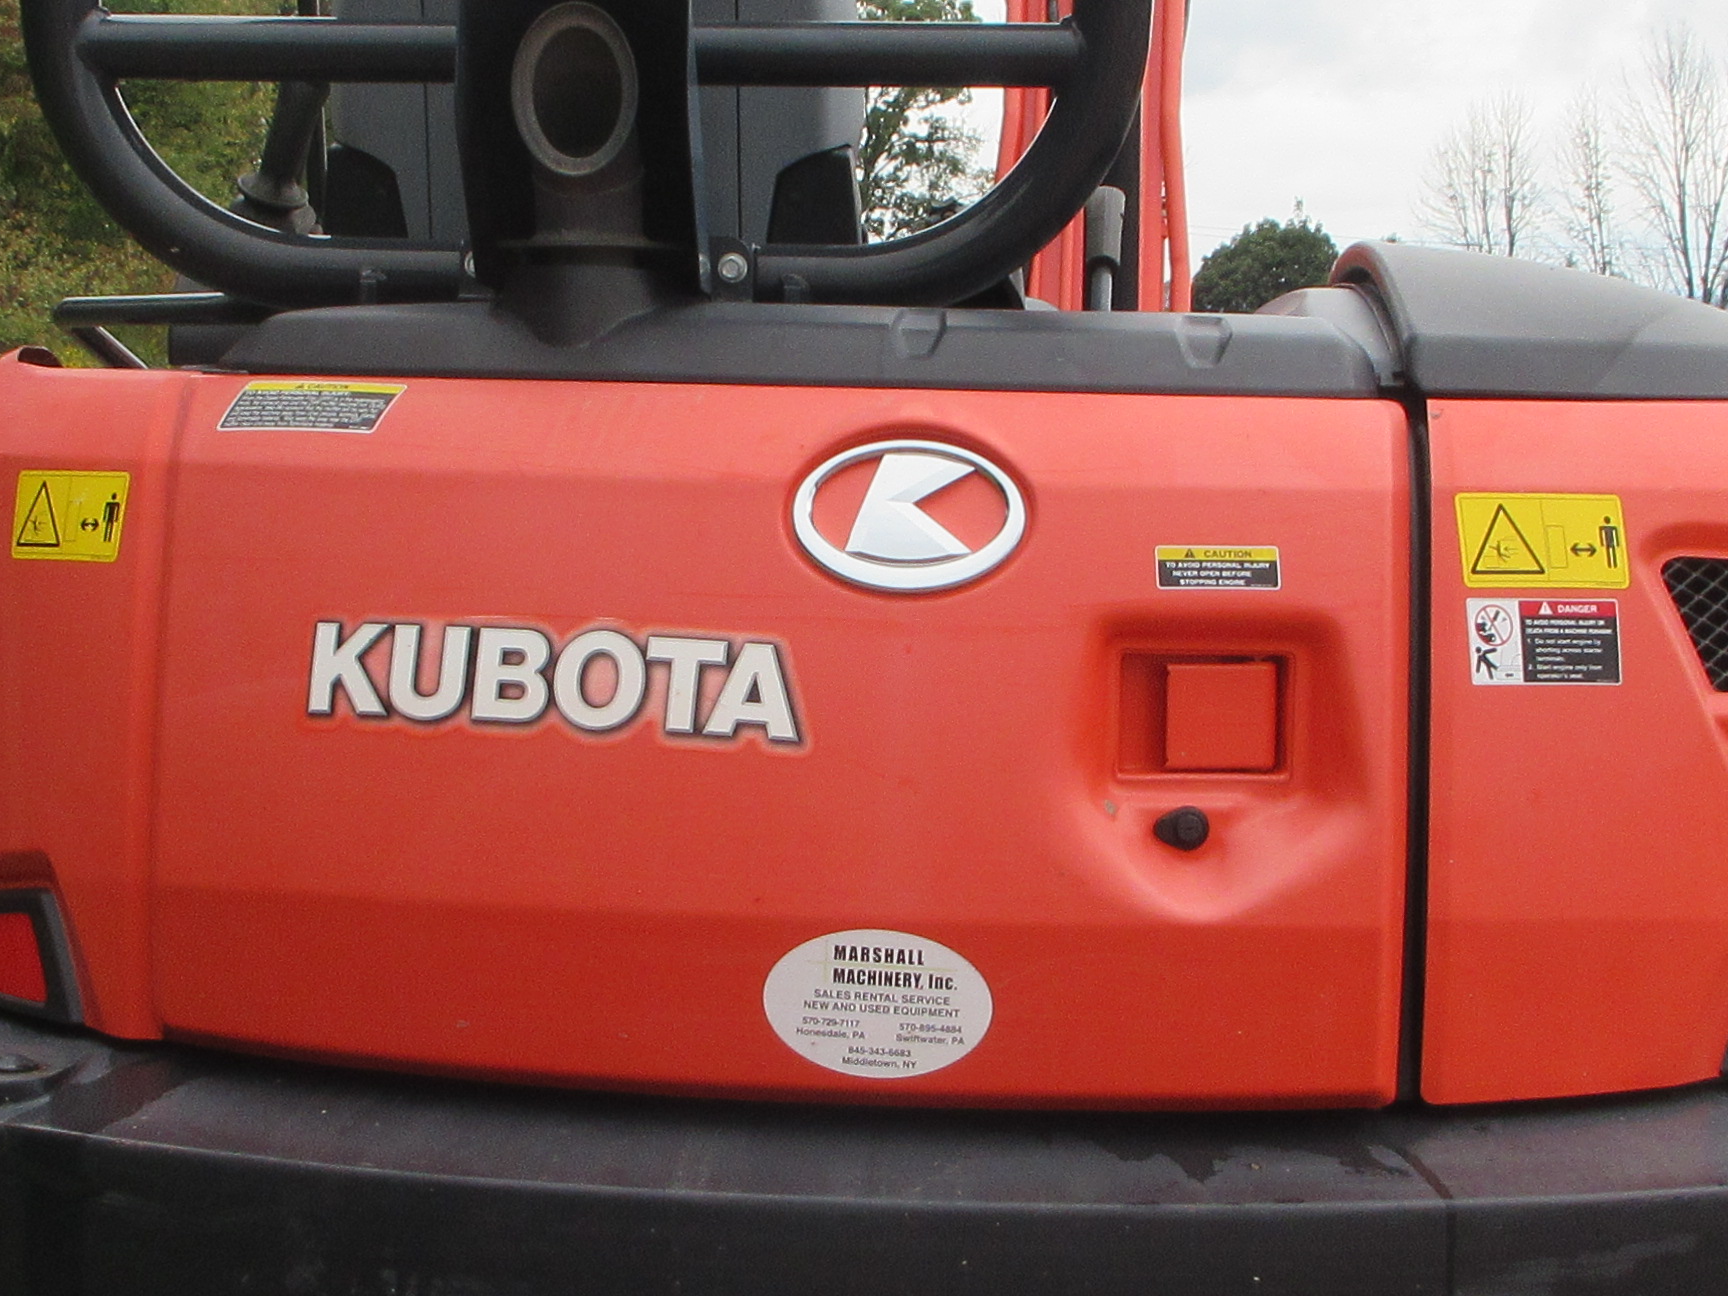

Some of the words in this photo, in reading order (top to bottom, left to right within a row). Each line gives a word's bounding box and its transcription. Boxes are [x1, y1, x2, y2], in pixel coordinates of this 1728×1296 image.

[1204, 550, 1252, 558] CAUTION
[1557, 604, 1598, 613] DANGER
[307, 621, 800, 742] KUBOTA
[833, 945, 925, 965] MARSHALL
[832, 968, 924, 990] MACHINERY,
[928, 974, 958, 990] Inc.
[814, 988, 851, 1000] SALES
[854, 991, 898, 1002] RENTAL
[902, 994, 950, 1005] SERVICE
[803, 1000, 830, 1010] NEW
[832, 1002, 856, 1012] AND
[859, 1005, 890, 1014] USED
[893, 1006, 960, 1018] EQUIPMENT
[802, 1016, 860, 1027] 570-729-7117
[796, 1027, 850, 1039] Honesdale,
[852, 1031, 865, 1039] PA
[896, 1034, 948, 1045] Swiftwater,
[951, 1036, 964, 1045] PA
[842, 1056, 900, 1069] Middletown,
[903, 1060, 917, 1069] NY
